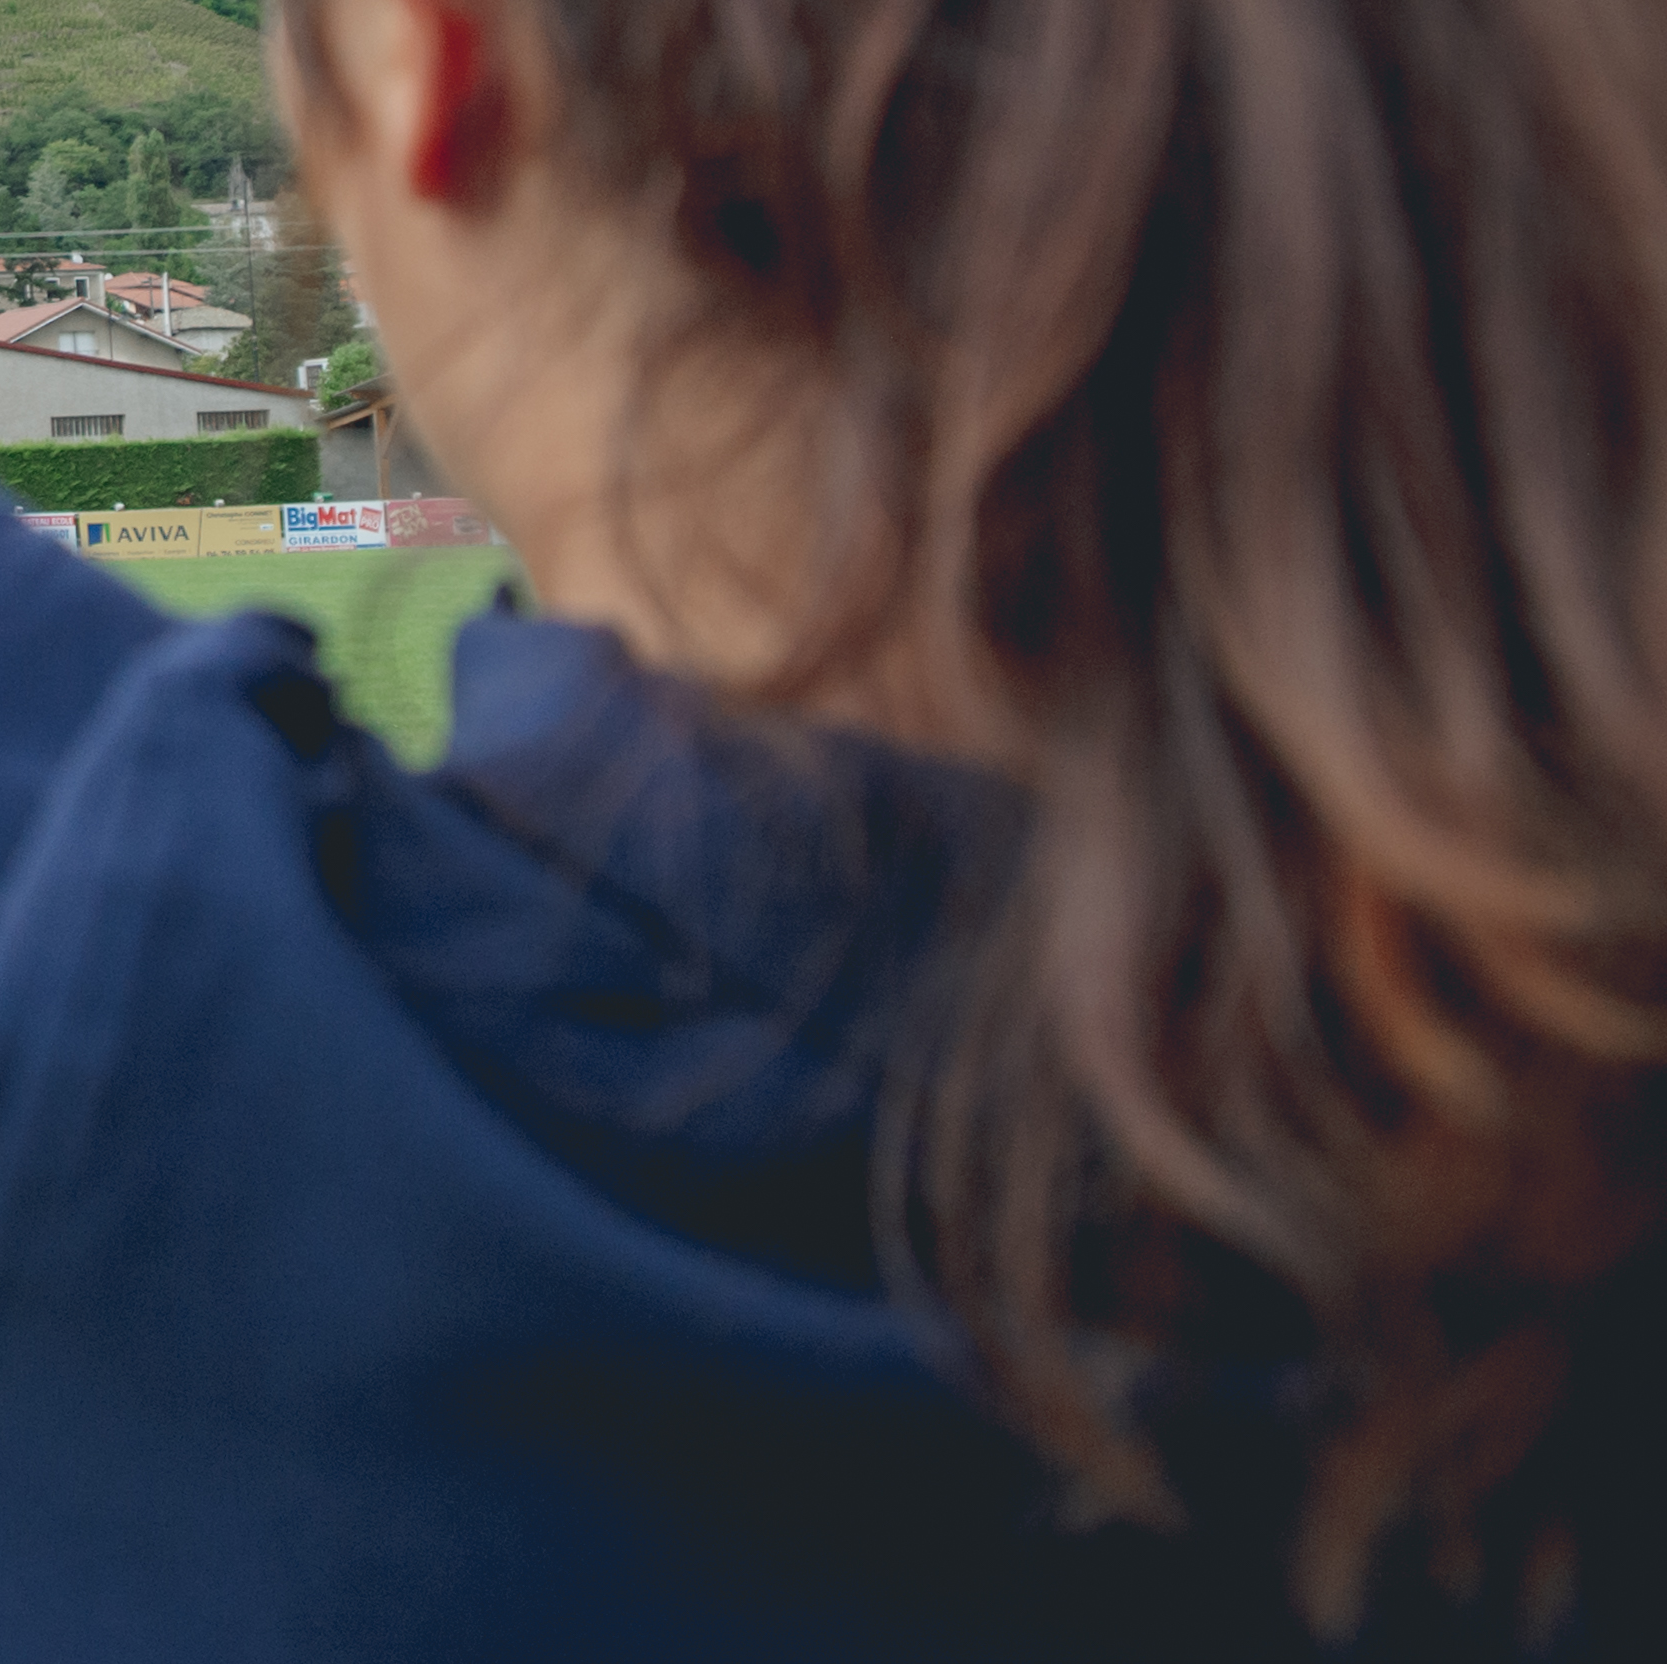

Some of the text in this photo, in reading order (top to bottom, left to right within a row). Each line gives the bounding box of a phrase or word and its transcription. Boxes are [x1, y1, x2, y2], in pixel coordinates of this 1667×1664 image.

[287, 505, 357, 530] BigMat
[117, 525, 189, 543] AVIVA
[288, 535, 358, 546] GIRARDON
